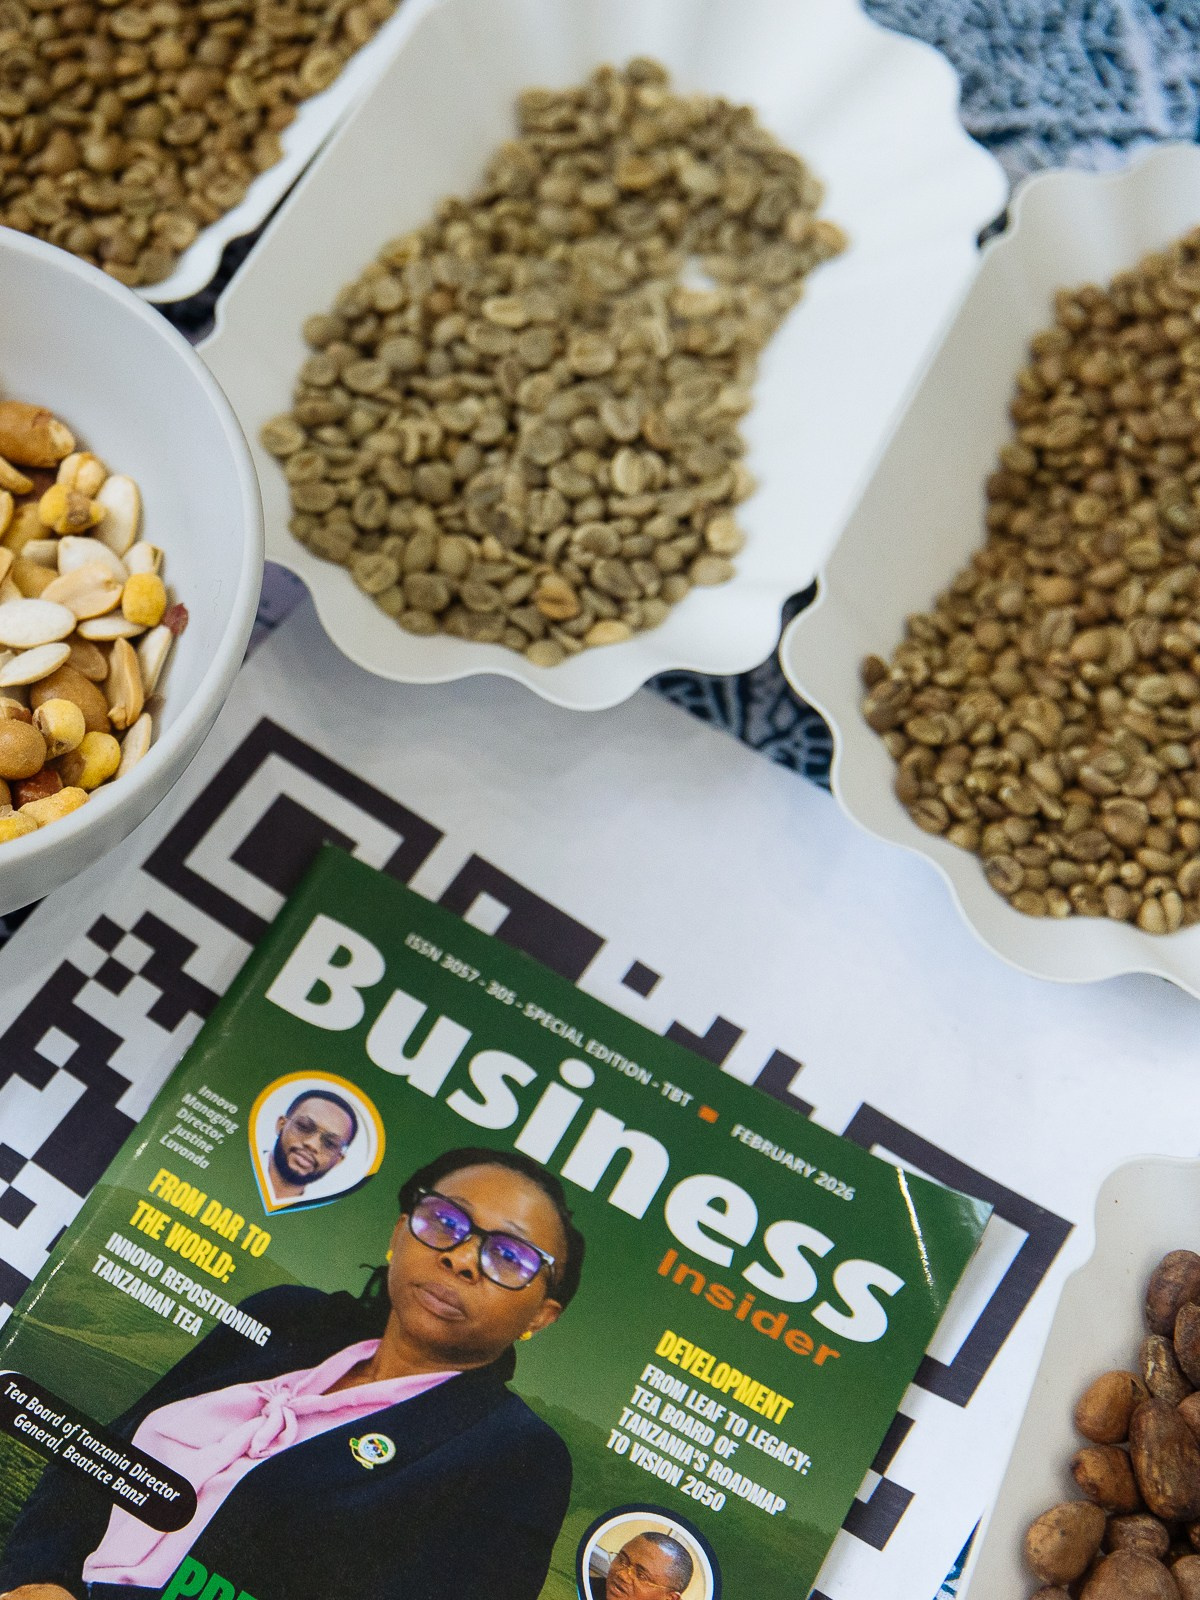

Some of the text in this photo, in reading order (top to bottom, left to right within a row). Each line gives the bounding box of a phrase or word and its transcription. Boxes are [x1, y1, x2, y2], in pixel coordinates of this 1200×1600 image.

[404, 932, 443, 962] ISSN
[522, 1001, 585, 1048] SPECIAL
[584, 1038, 653, 1086] EDITION
[660, 1081, 694, 1107] TBT
[168, 1123, 214, 1154] Justine
[176, 1107, 224, 1145] Director,
[181, 1093, 239, 1134] Managing
[197, 1085, 238, 1114] Innovo
[264, 913, 906, 1344] Business
[159, 1133, 210, 1169] Luvanda
[730, 1123, 856, 1201] FEBRUARY 2026
[129, 1199, 236, 1284] THE WORLD:
[148, 1168, 272, 1258] FROM DAR TO
[91, 1254, 204, 1338] TANZANIAN TEA
[104, 1231, 272, 1347] INNOVO REPOSITIONING
[657, 1248, 841, 1366] Insider
[640, 1363, 812, 1476] FROM LEAF TO LEGACY:
[654, 1329, 795, 1425] DEVELOPMENT
[3, 1381, 181, 1502] Tea Board of Tanzania Director
[13, 1413, 150, 1507] General, Beatrice Banzi
[617, 1406, 787, 1516] TANZANIA'S ROADMAP
[630, 1384, 739, 1460] TEA BOARD OF
[605, 1428, 726, 1512] TO VISION 2050
